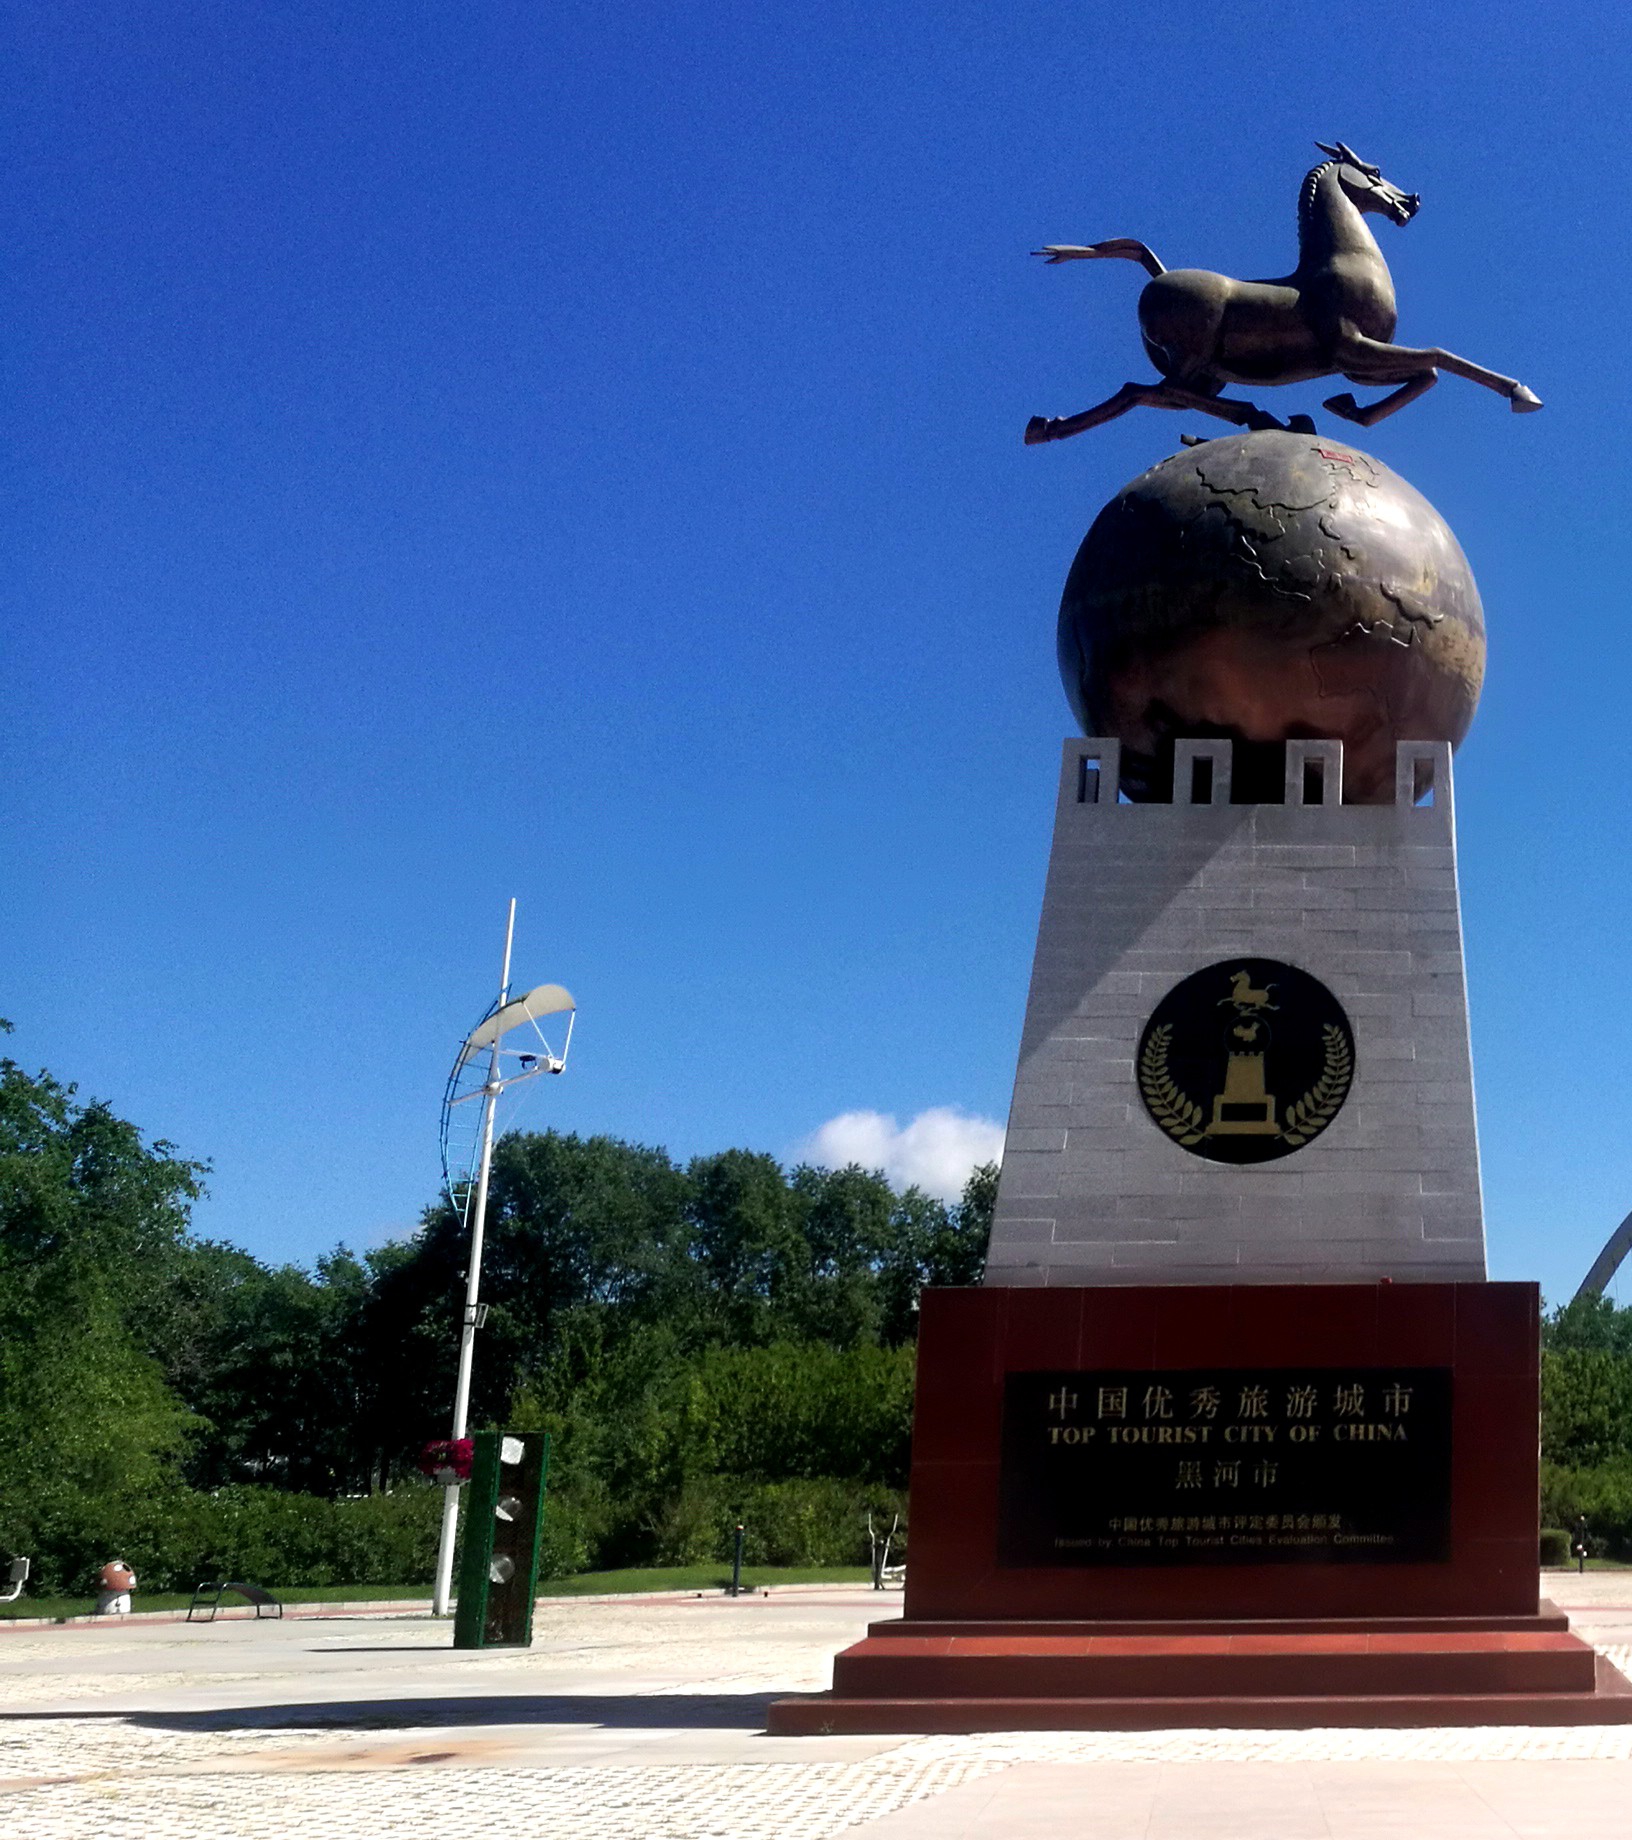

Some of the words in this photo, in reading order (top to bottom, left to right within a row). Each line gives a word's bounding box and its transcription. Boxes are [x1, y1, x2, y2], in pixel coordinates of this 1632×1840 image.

[1048, 1382, 1414, 1420] 中国优秀旅游城市
[1048, 1426, 1096, 1444] TOP
[1107, 1425, 1213, 1444] TOURIST
[1224, 1425, 1278, 1444] CITY
[1289, 1424, 1322, 1443] OF
[1333, 1422, 1409, 1443] CHINA
[1175, 1459, 1279, 1489] 黑河市
[1098, 1537, 1113, 1549] by
[1118, 1535, 1151, 1547] China
[1159, 1535, 1179, 1549] Top
[1184, 1535, 1225, 1547] Tourist
[1269, 1533, 1328, 1546] Evaluation
[1333, 1532, 1395, 1546] Committee
